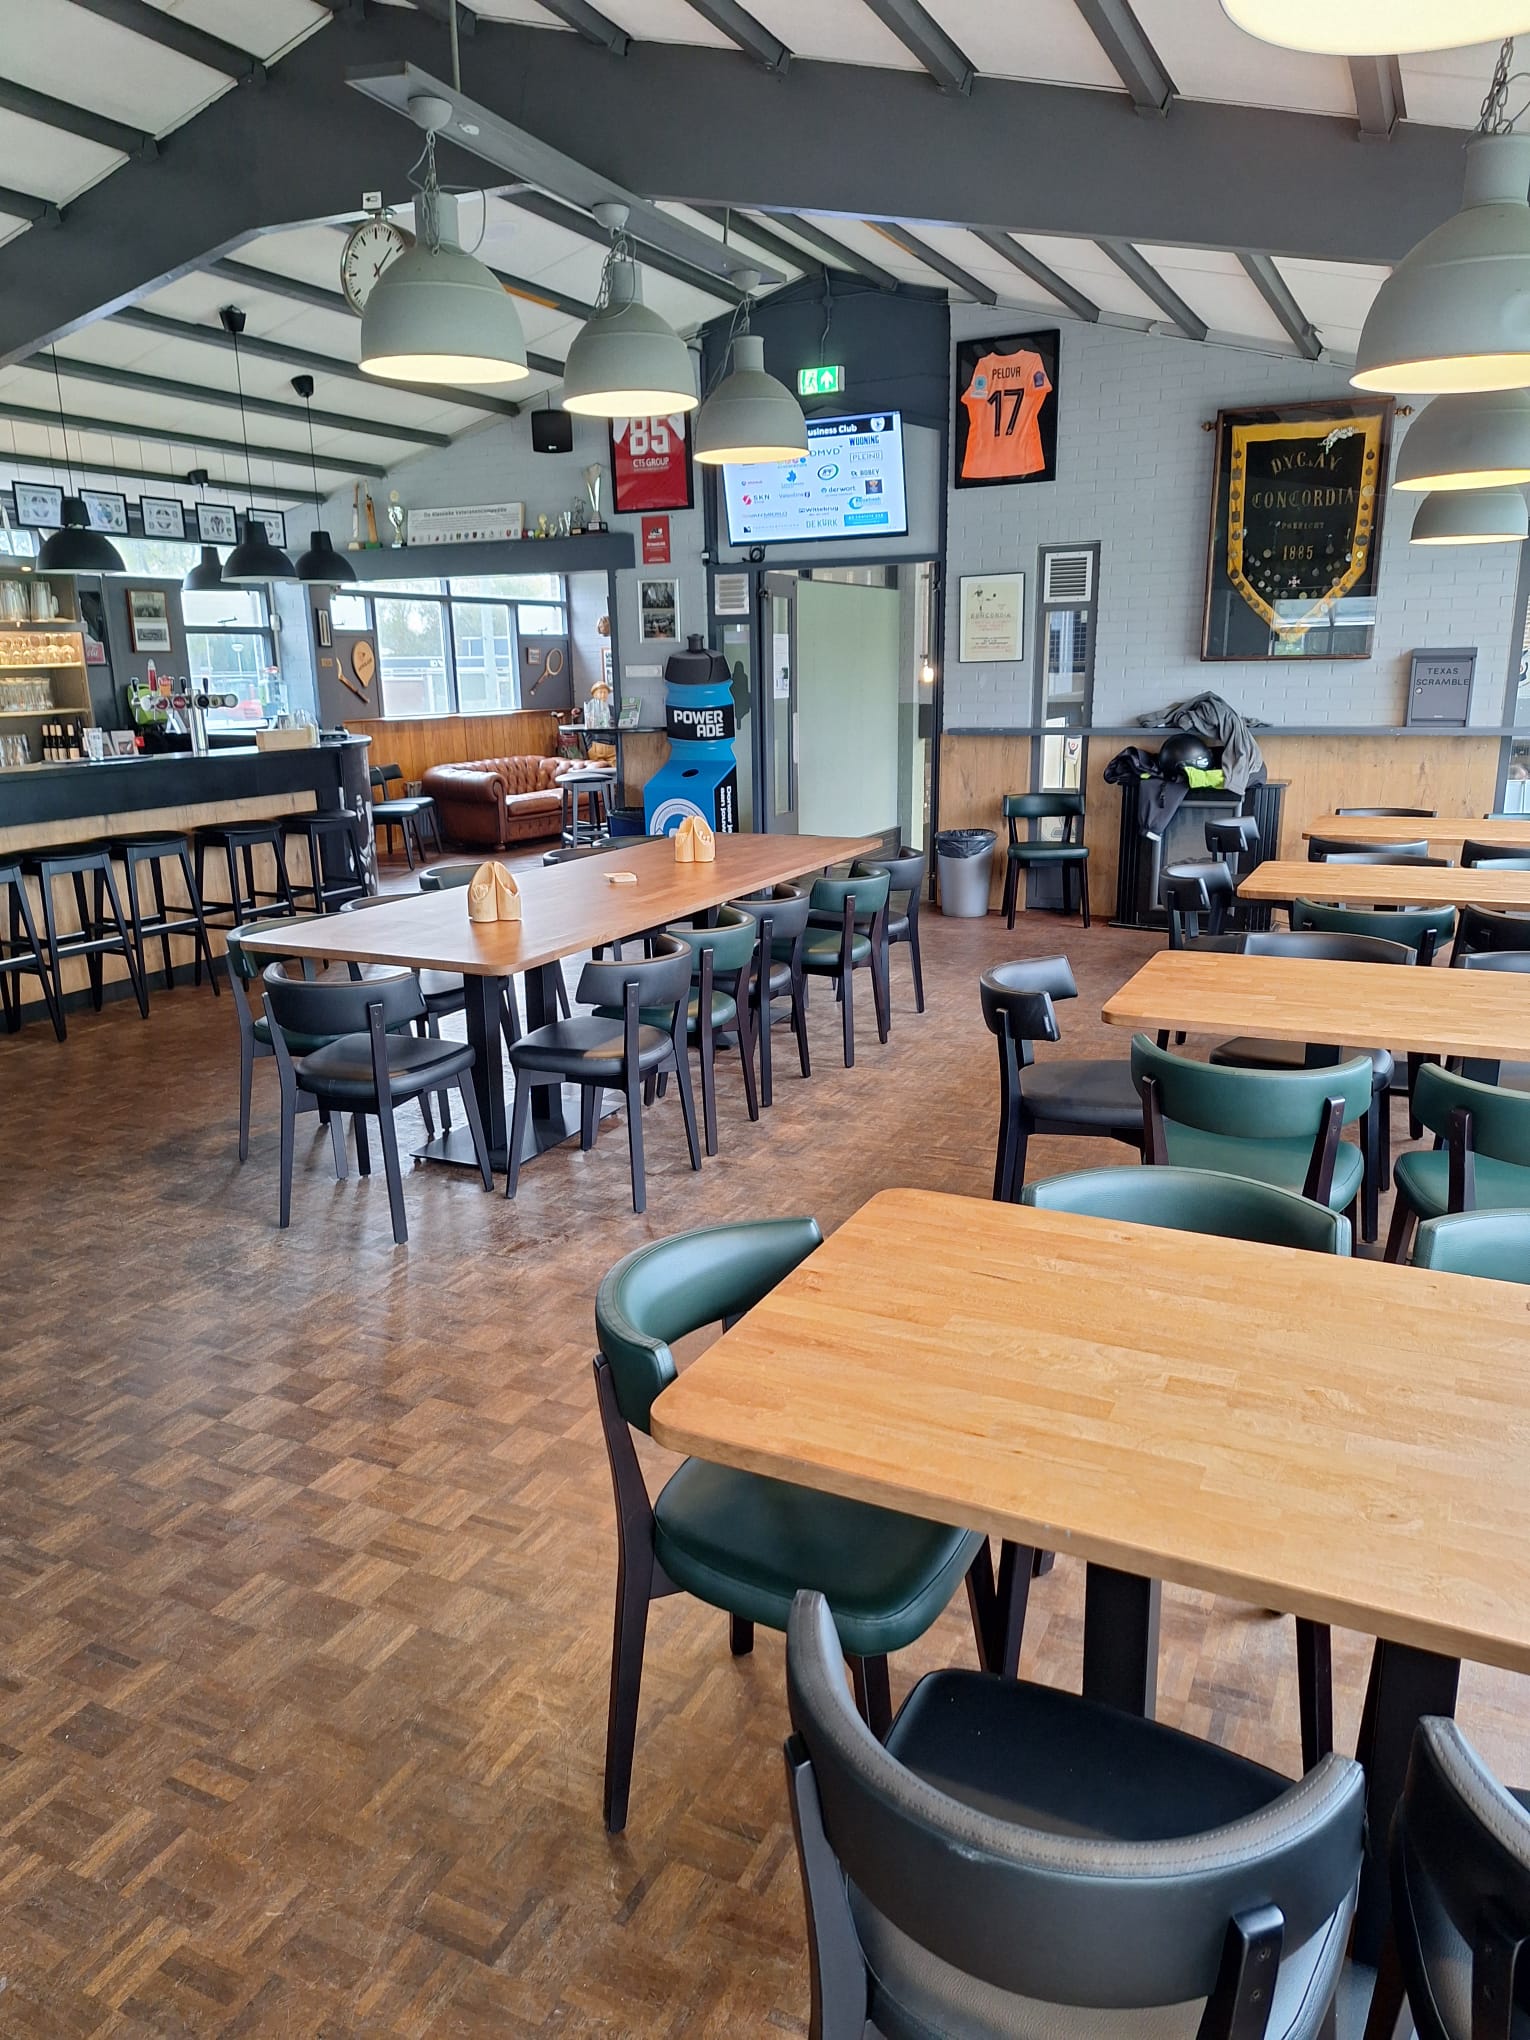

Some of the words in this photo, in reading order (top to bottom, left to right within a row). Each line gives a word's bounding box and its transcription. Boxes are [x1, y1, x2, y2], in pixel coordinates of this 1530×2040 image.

[991, 366, 1021, 380] PELOVA
[987, 388, 1025, 438] 17
[630, 416, 670, 456] 85
[808, 427, 837, 437] usiness
[838, 423, 858, 434] Club
[645, 456, 670, 468] GROUP
[1251, 487, 1354, 510] CONCORDIA
[1283, 545, 1313, 560] 1885
[1427, 667, 1459, 675] TEXAS
[1415, 678, 1470, 686] SCRAMBLE
[674, 710, 724, 724] POWER
[696, 724, 725, 738] ADE
